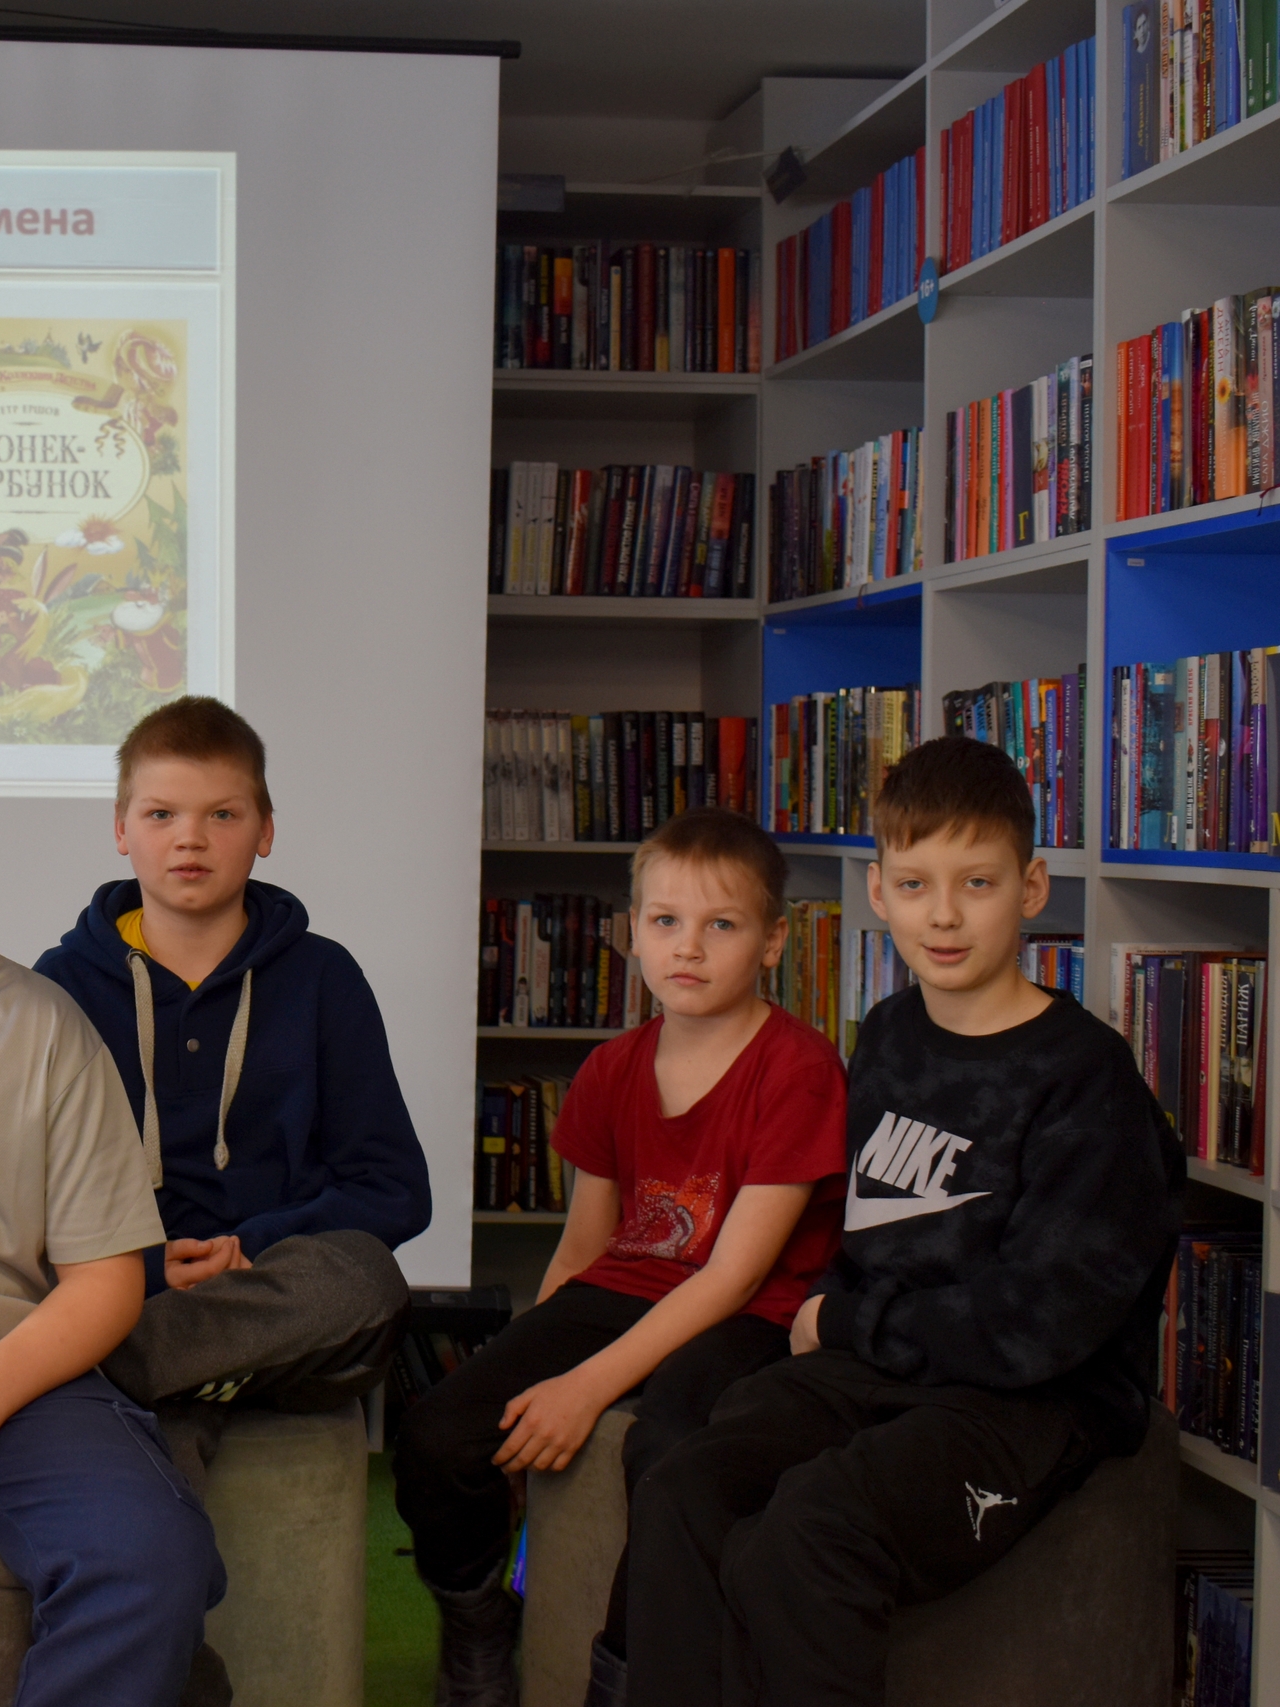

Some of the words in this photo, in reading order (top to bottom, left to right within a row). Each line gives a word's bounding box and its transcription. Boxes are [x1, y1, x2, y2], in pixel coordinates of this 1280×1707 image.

[919, 278, 935, 300] 16+
[22, 404, 60, 417] ЕРШОВ
[1261, 400, 1269, 448] ДЖИО
[597, 949, 610, 1015] ЛОКДАУН
[1237, 984, 1249, 1045] ПАРИЖ
[856, 1110, 973, 1199] NIKE
